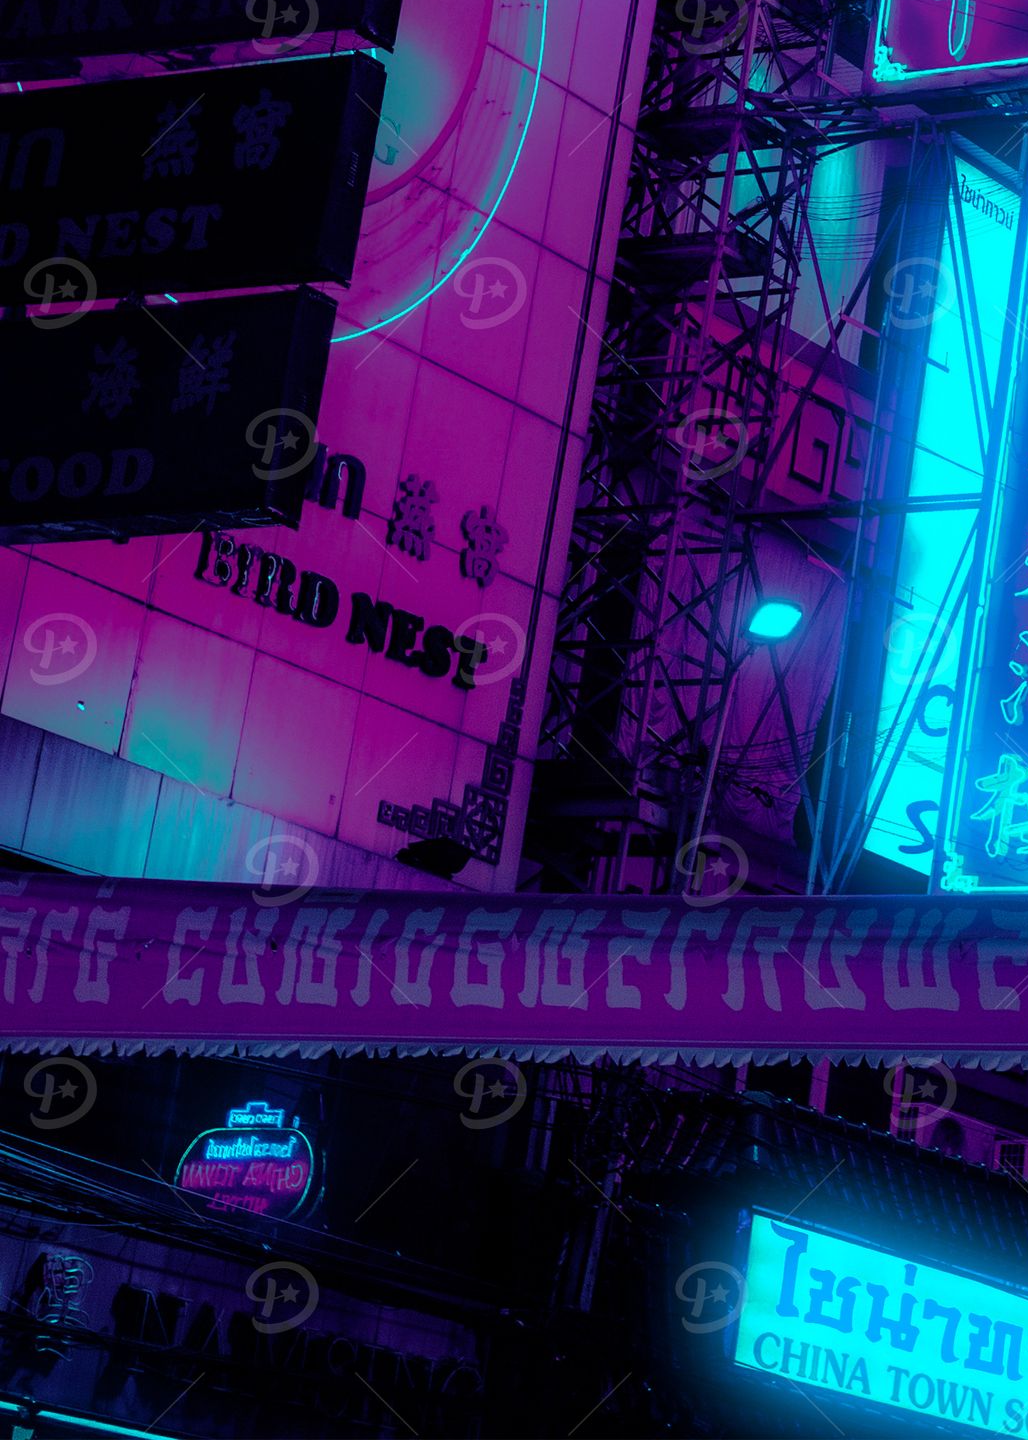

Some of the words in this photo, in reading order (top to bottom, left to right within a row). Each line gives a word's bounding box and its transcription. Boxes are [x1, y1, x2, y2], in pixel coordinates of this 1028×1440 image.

[56, 202, 225, 257] NEST
[194, 524, 340, 629] BIRD
[345, 591, 488, 690] NEST
[752, 1331, 871, 1396] CHINA
[886, 1364, 995, 1428] TOWN
